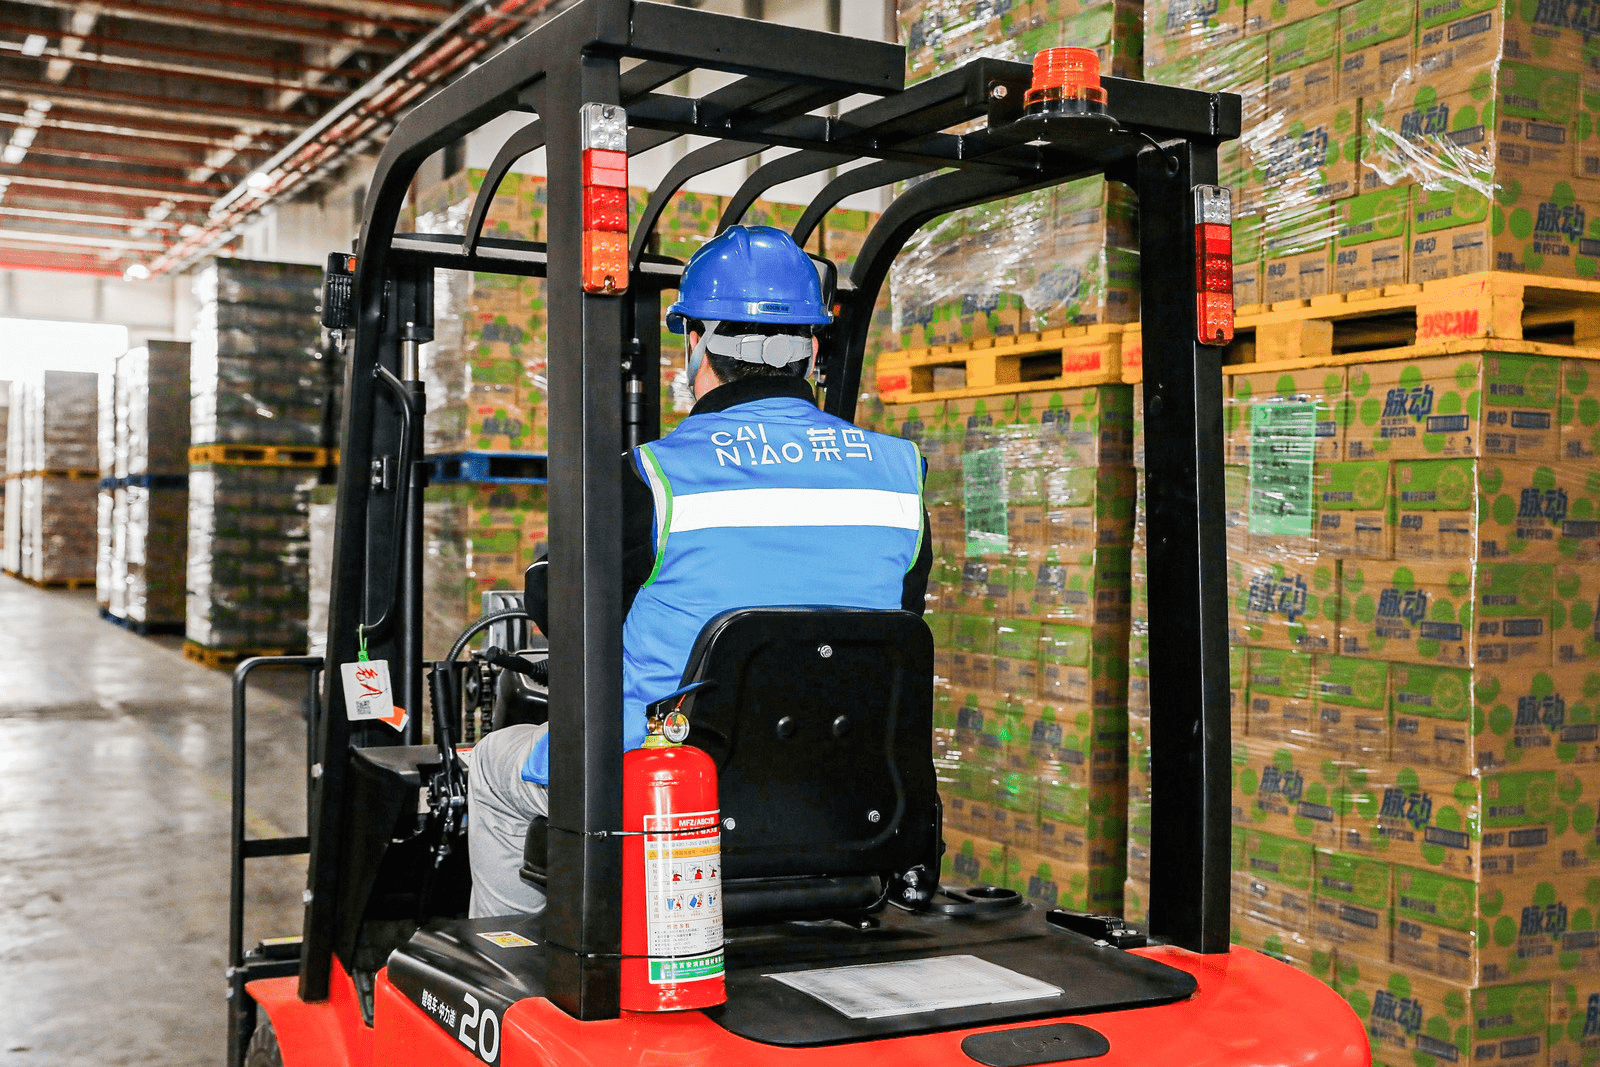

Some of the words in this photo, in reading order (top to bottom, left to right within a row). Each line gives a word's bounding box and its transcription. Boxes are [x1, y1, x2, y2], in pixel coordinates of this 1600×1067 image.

[1535, 202, 1585, 241] 脉动
[1382, 385, 1434, 423] 脉动
[710, 423, 767, 446] CAI
[806, 427, 873, 462] 菜鸟
[1517, 487, 1568, 525] 脉动
[1378, 589, 1427, 626] 脉动
[1516, 693, 1565, 732] 脉动
[1379, 788, 1432, 830] 脉动
[458, 992, 500, 1063] 20
[1372, 989, 1422, 1035] 脉动
